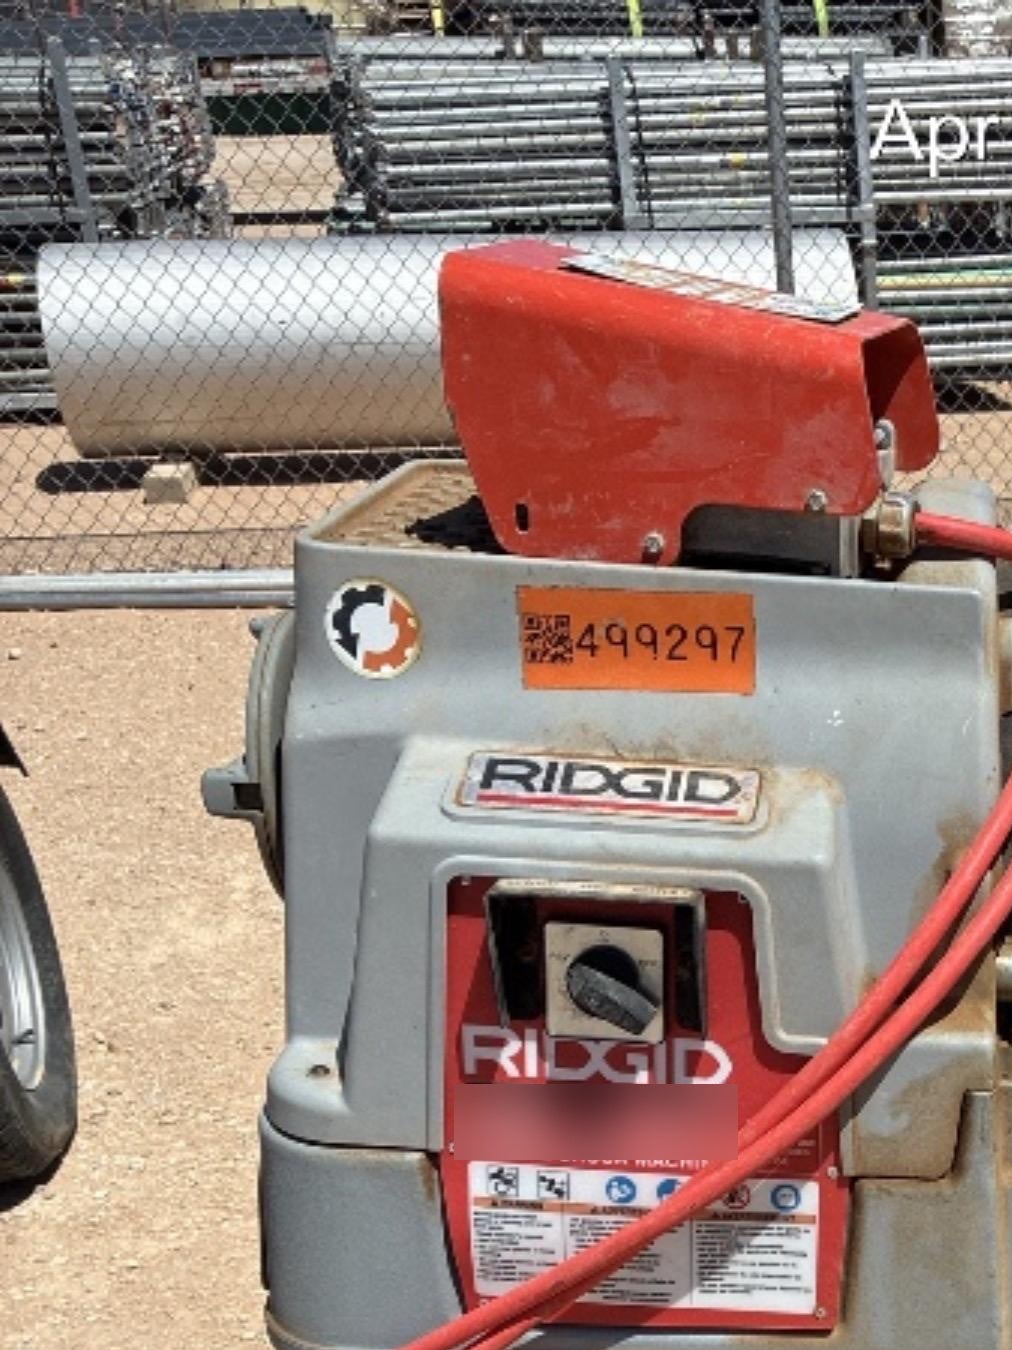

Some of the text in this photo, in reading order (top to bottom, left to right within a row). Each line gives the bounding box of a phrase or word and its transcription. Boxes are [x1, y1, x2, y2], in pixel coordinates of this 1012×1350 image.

[575, 622, 746, 663] 499297
[479, 757, 742, 804] RIDGID
[461, 1023, 733, 1085] RIDGID
